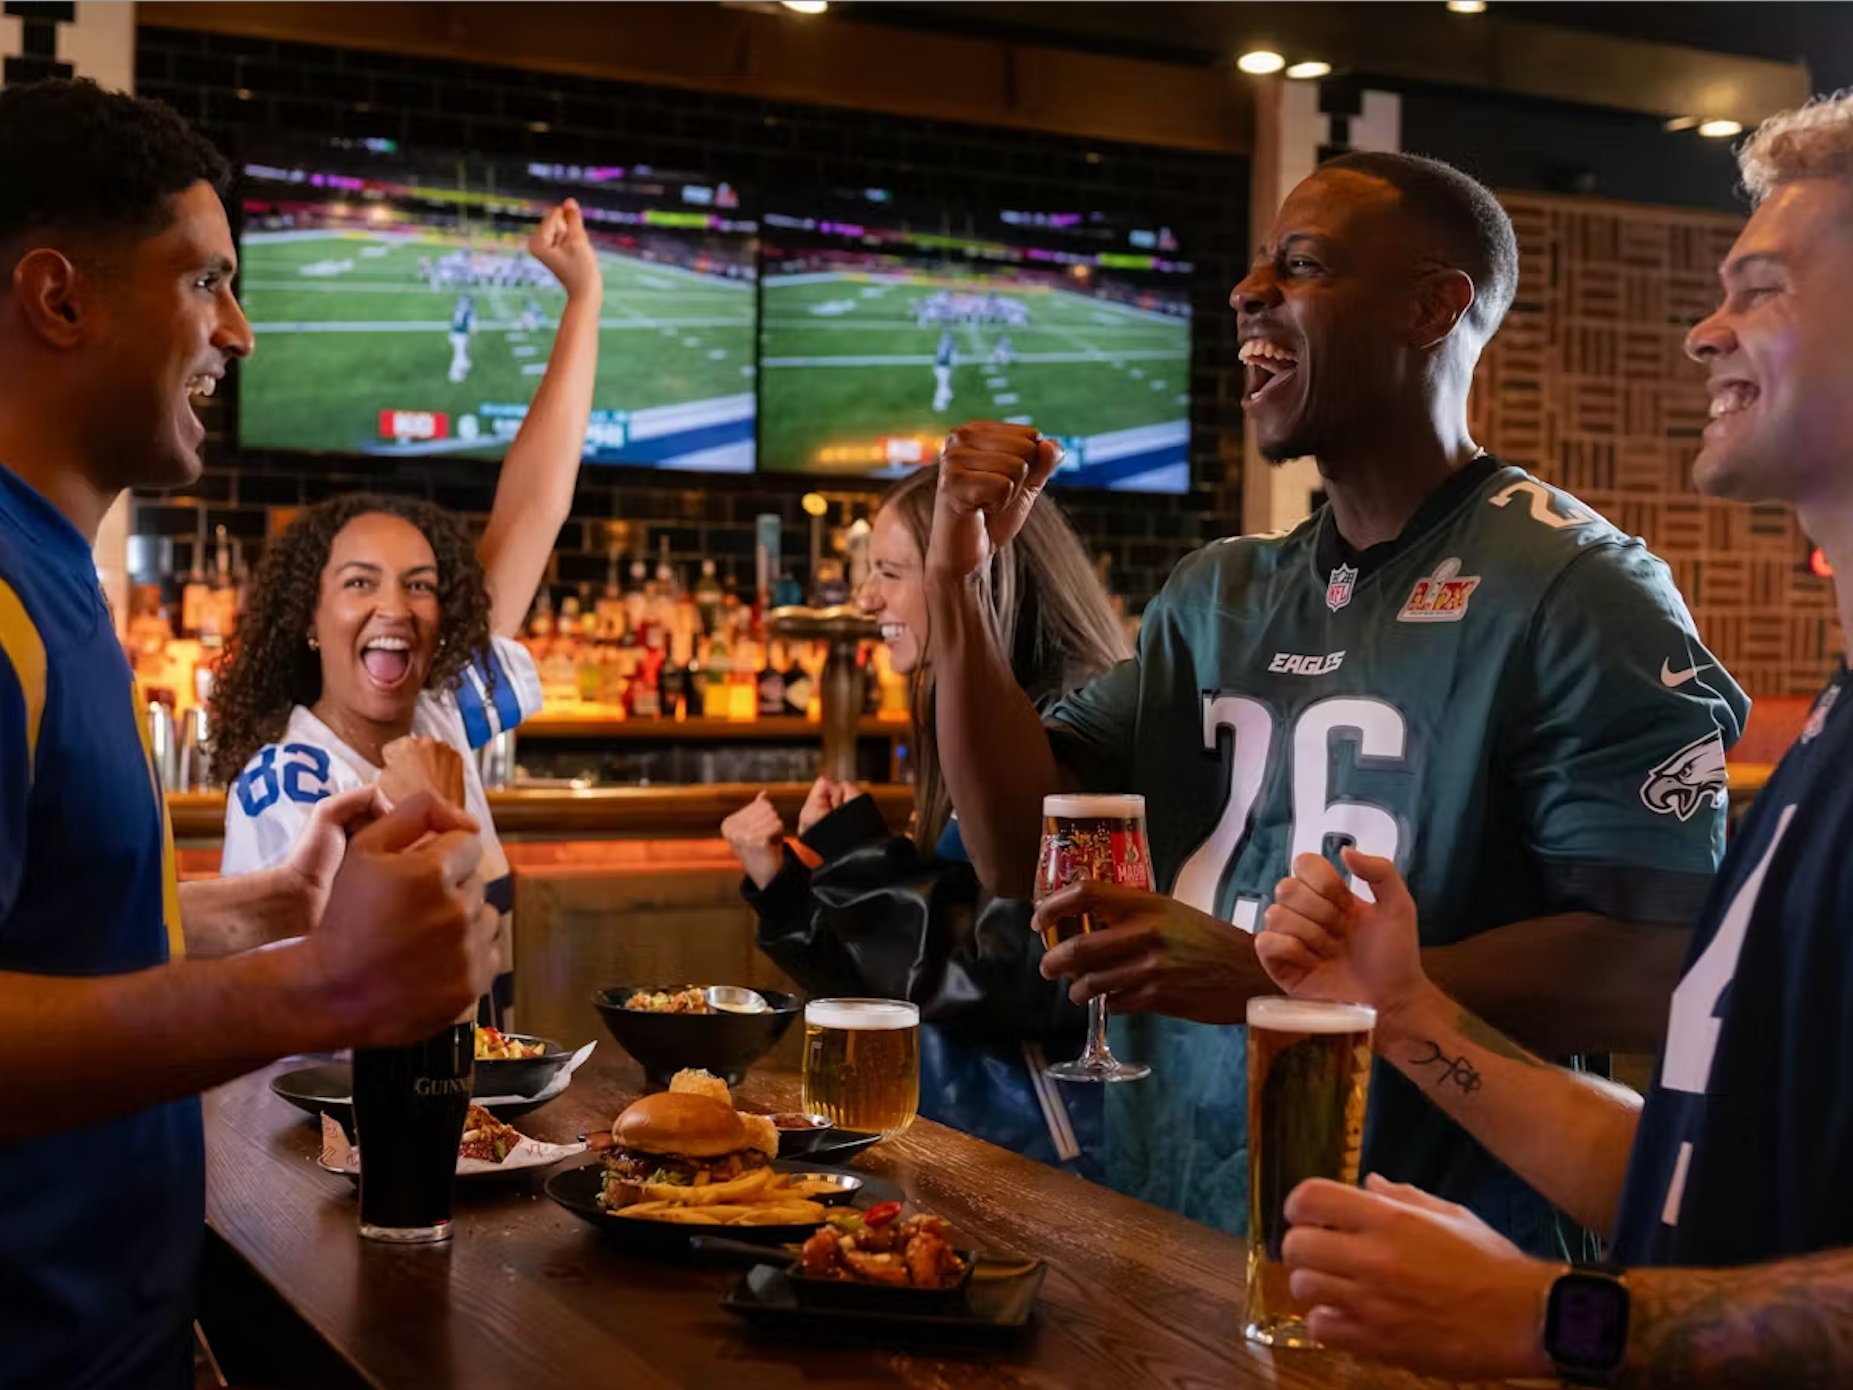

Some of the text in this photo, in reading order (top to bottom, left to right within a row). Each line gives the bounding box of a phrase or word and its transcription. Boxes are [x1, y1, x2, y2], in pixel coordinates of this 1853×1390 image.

[1267, 650, 1346, 676] EAGLES
[236, 743, 331, 817] 82
[1172, 694, 1405, 933] 26
